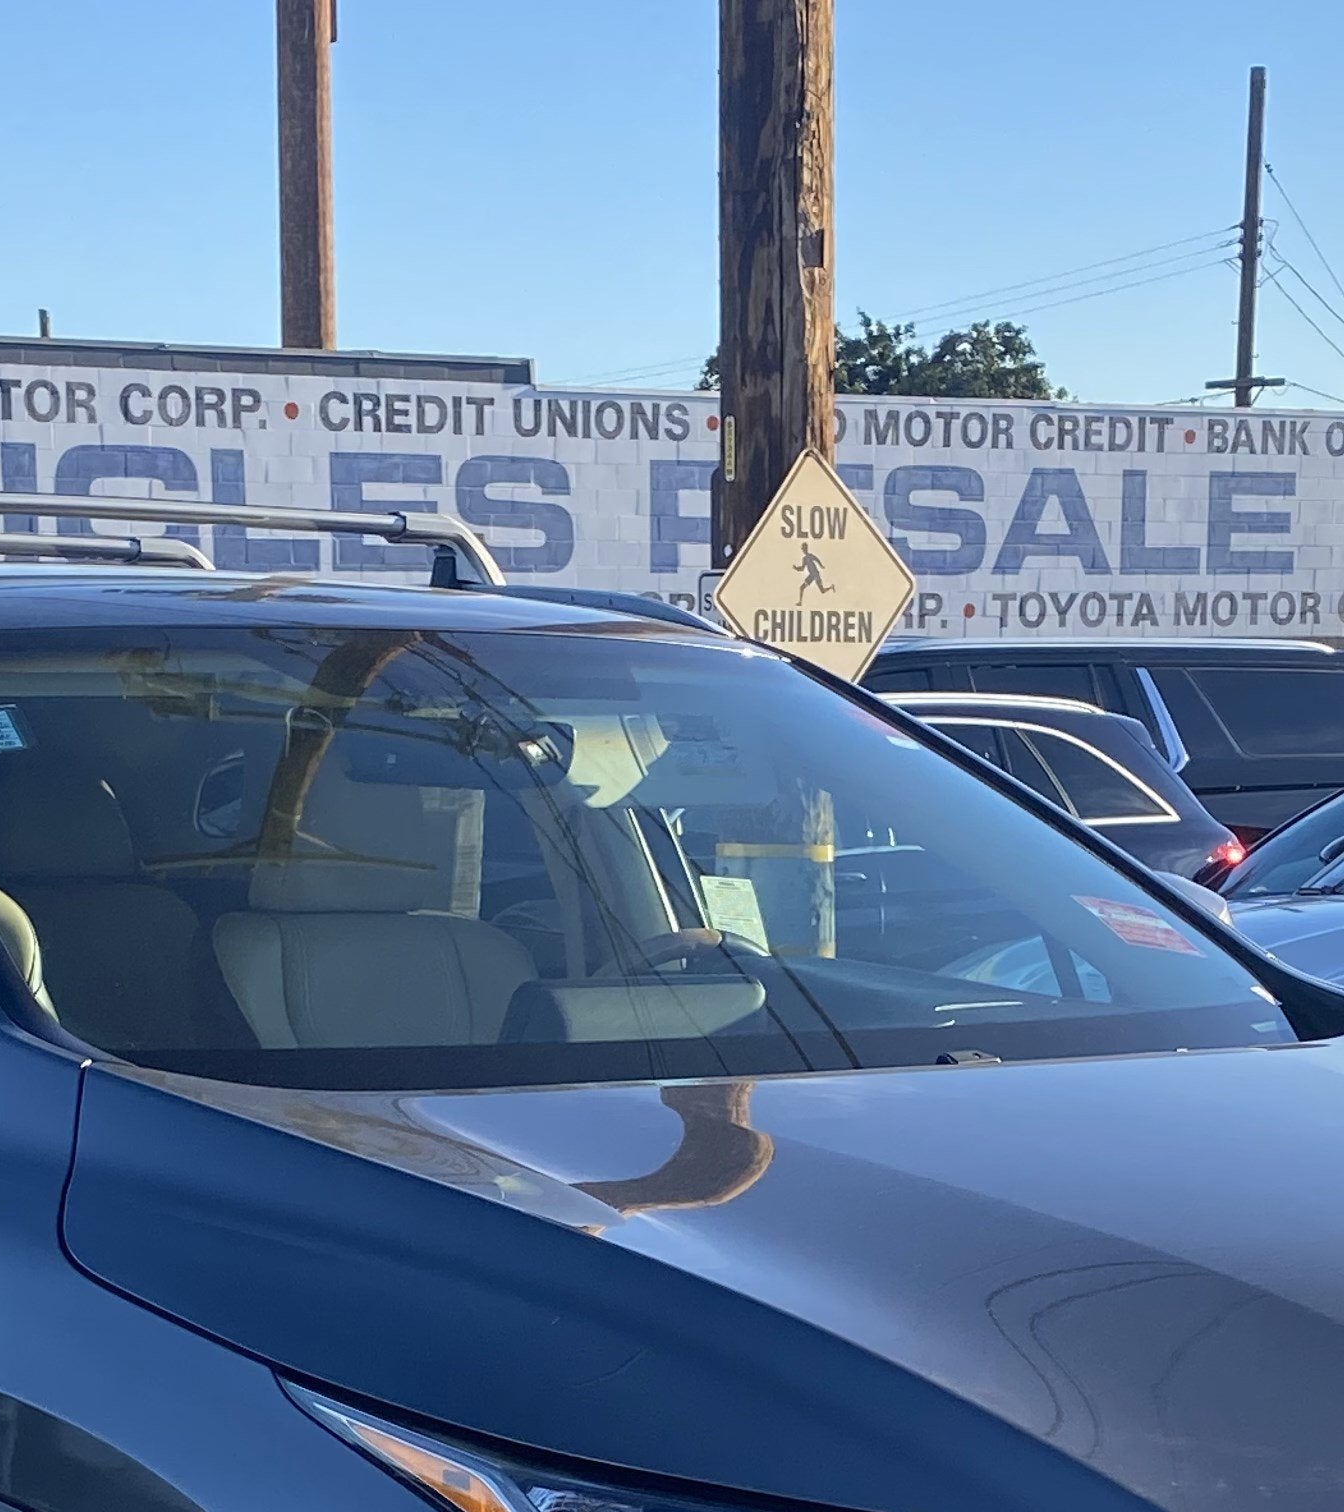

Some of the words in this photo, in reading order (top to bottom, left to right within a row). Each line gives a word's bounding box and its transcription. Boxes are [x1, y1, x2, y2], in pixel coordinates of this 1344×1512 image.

[118, 382, 267, 431] CORP.
[319, 390, 494, 435] CREDIT
[513, 398, 690, 442] UNIONS
[863, 409, 1014, 451] MOTOR
[1029, 413, 1174, 453] CREDIT
[1207, 419, 1311, 456] BANK
[650, 455, 1296, 575] RSALE
[781, 505, 848, 541] SLOW
[754, 610, 873, 644] CHILDREN
[992, 591, 1159, 629] TOYOTA
[1173, 591, 1321, 627] MOTOR
